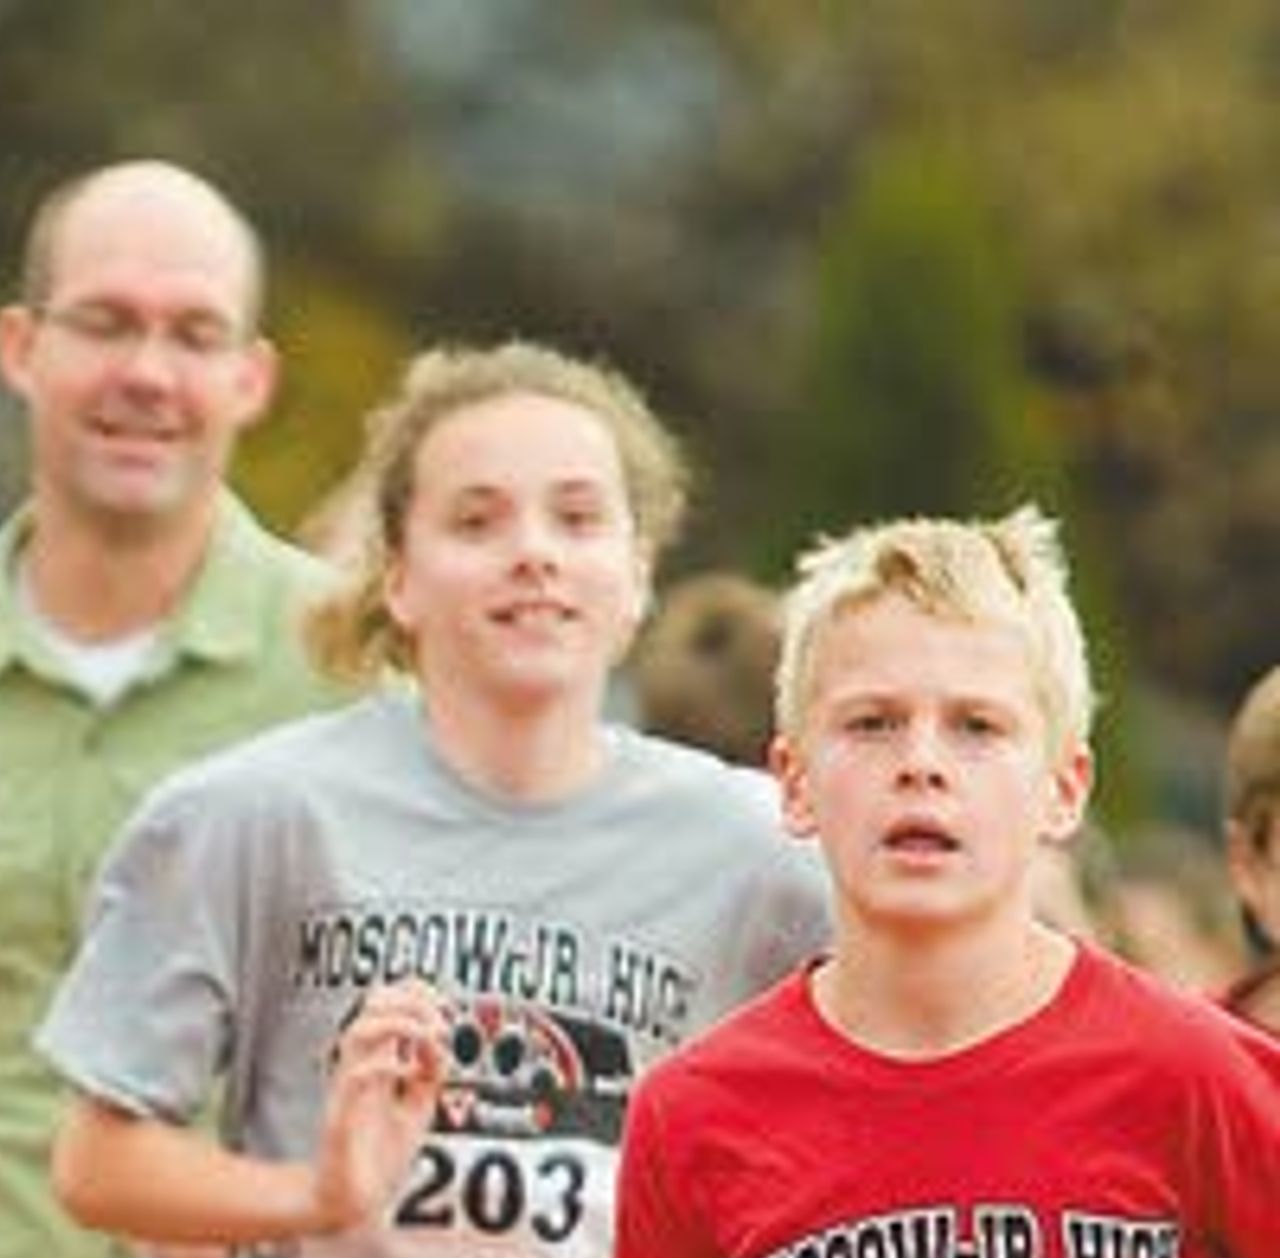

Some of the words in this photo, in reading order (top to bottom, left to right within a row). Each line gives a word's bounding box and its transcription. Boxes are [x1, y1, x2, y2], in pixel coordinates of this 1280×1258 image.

[295, 912, 510, 992] MOSCOW
[606, 940, 694, 1042] HIG
[395, 1146, 586, 1243] 203
